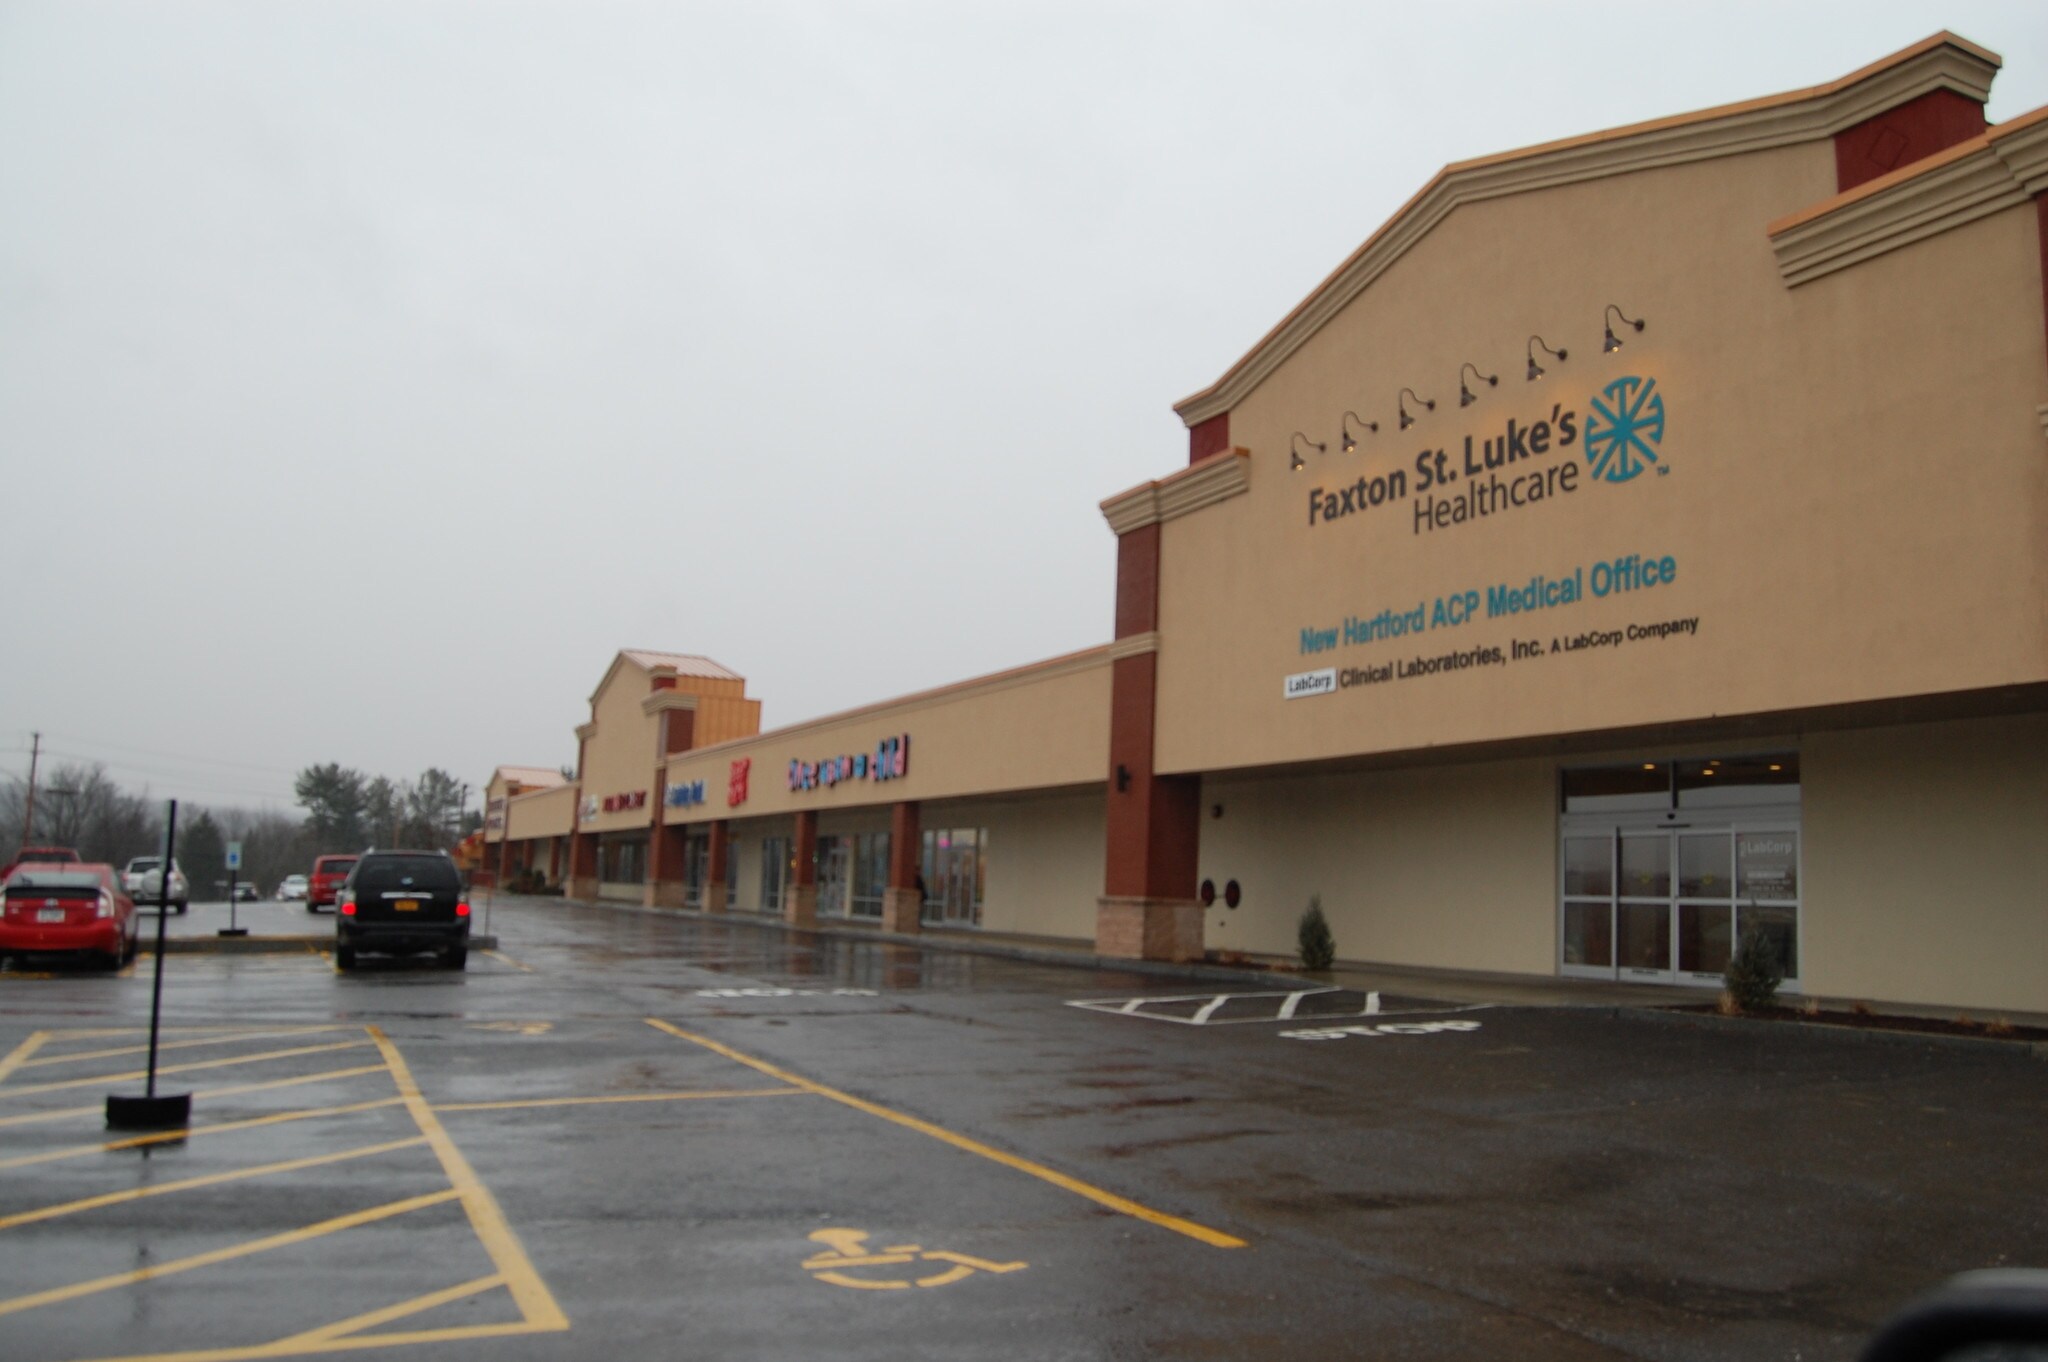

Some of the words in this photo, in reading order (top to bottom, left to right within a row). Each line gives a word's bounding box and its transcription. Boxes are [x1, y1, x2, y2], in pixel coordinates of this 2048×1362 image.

[1309, 468, 1407, 526] Faxton
[1415, 448, 1457, 492] St.
[1464, 402, 1578, 476] Luke's
[1413, 460, 1579, 535] Healthcare
[1299, 626, 1339, 655] New
[1343, 602, 1425, 646] Hartford
[1430, 589, 1480, 629] ACP
[1487, 566, 1583, 618] Medical
[1590, 554, 1677, 598] Office
[1288, 673, 1333, 694] LabCorp
[1340, 661, 1394, 689] Clinical
[1397, 644, 1507, 680] Laboratories,
[1511, 638, 1545, 661] Inc.
[1550, 637, 1561, 654] A
[1564, 630, 1624, 652] LabCorp
[1626, 615, 1700, 642] Company
